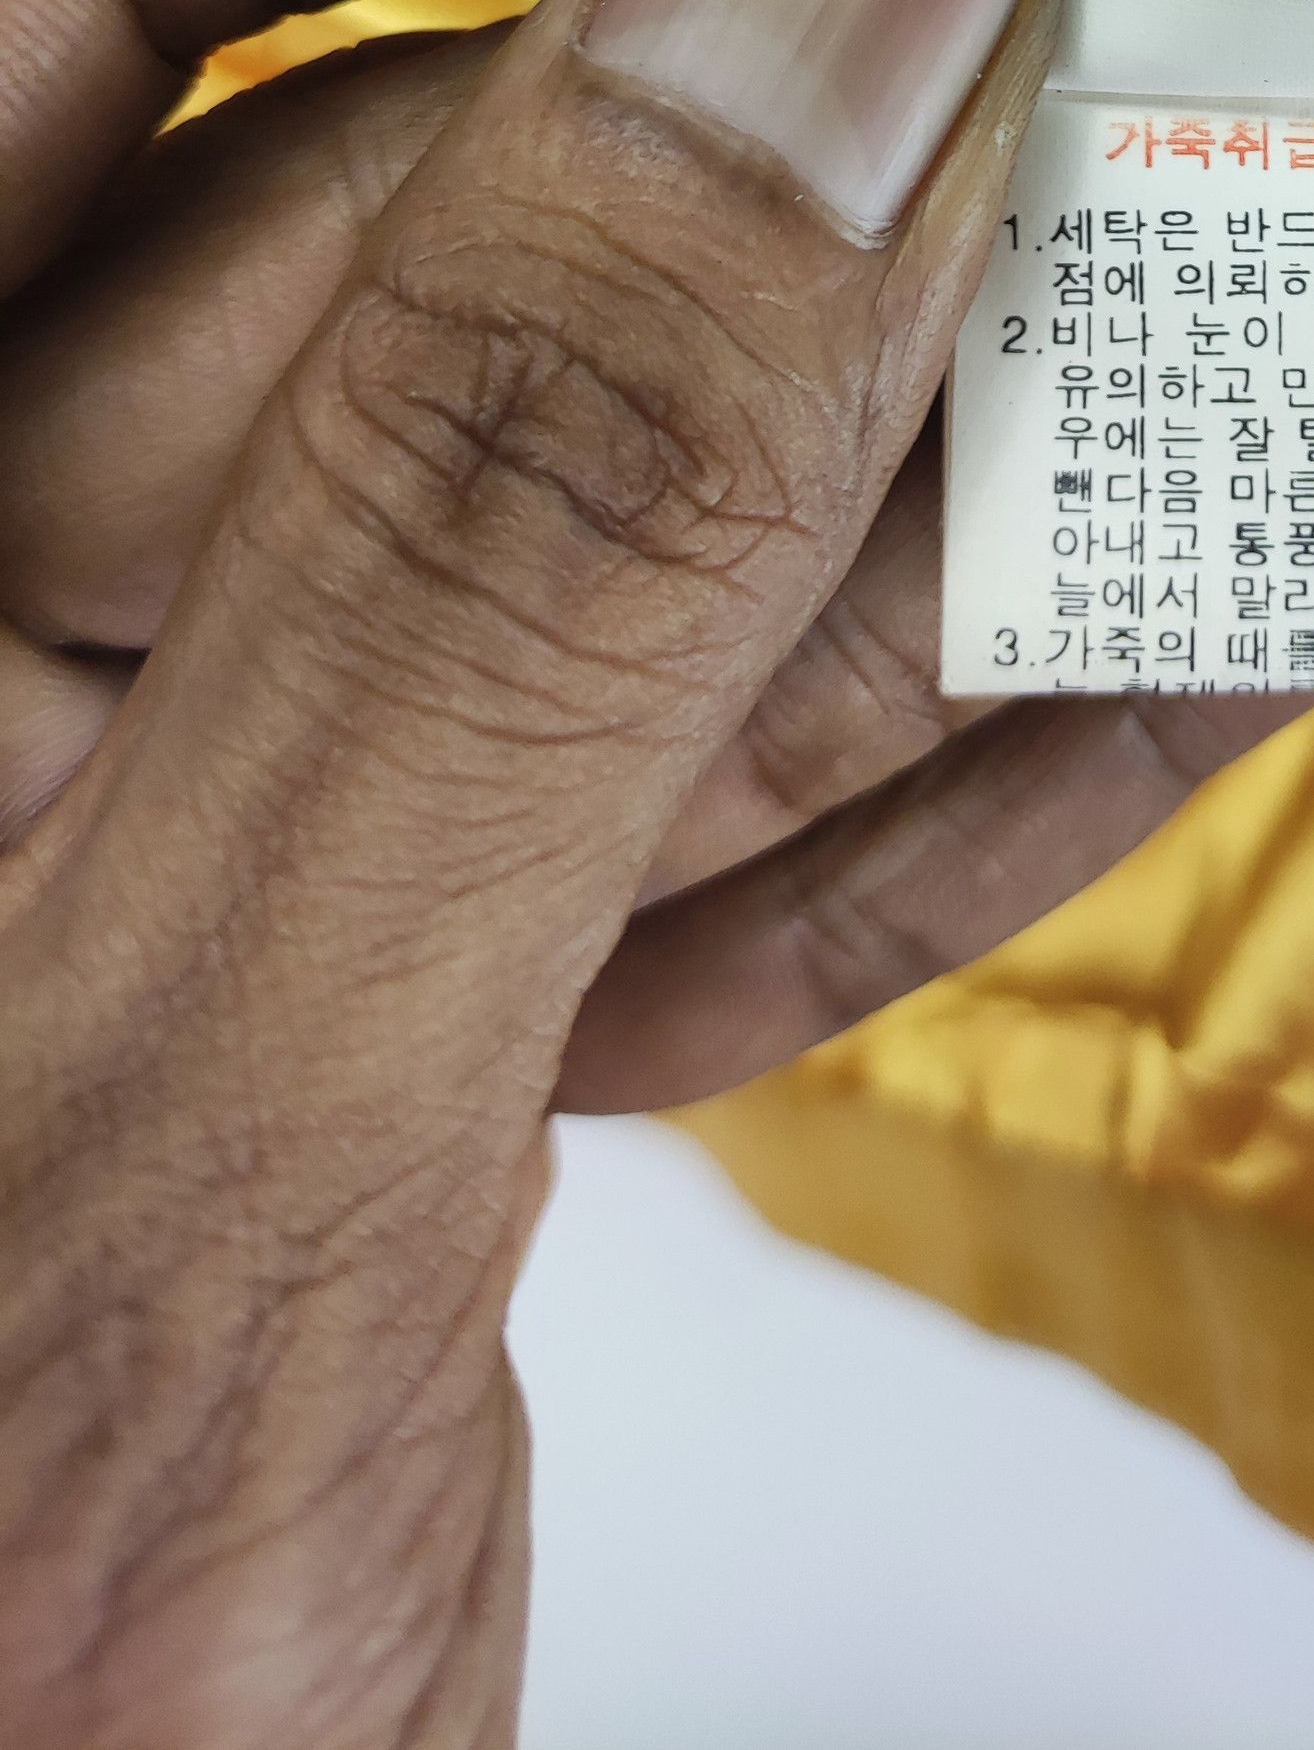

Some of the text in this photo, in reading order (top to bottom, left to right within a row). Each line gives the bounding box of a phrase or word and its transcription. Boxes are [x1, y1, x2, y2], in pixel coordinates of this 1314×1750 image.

[1052, 259, 1145, 307] 점에
[1184, 310, 1283, 357] 눈이
[1054, 362, 1257, 410] 유의하고
[1053, 414, 1205, 461] 우에는
[1228, 415, 1276, 463] 잘
[1052, 518, 1204, 566] 아내고
[1050, 571, 1198, 620] 늘에서
